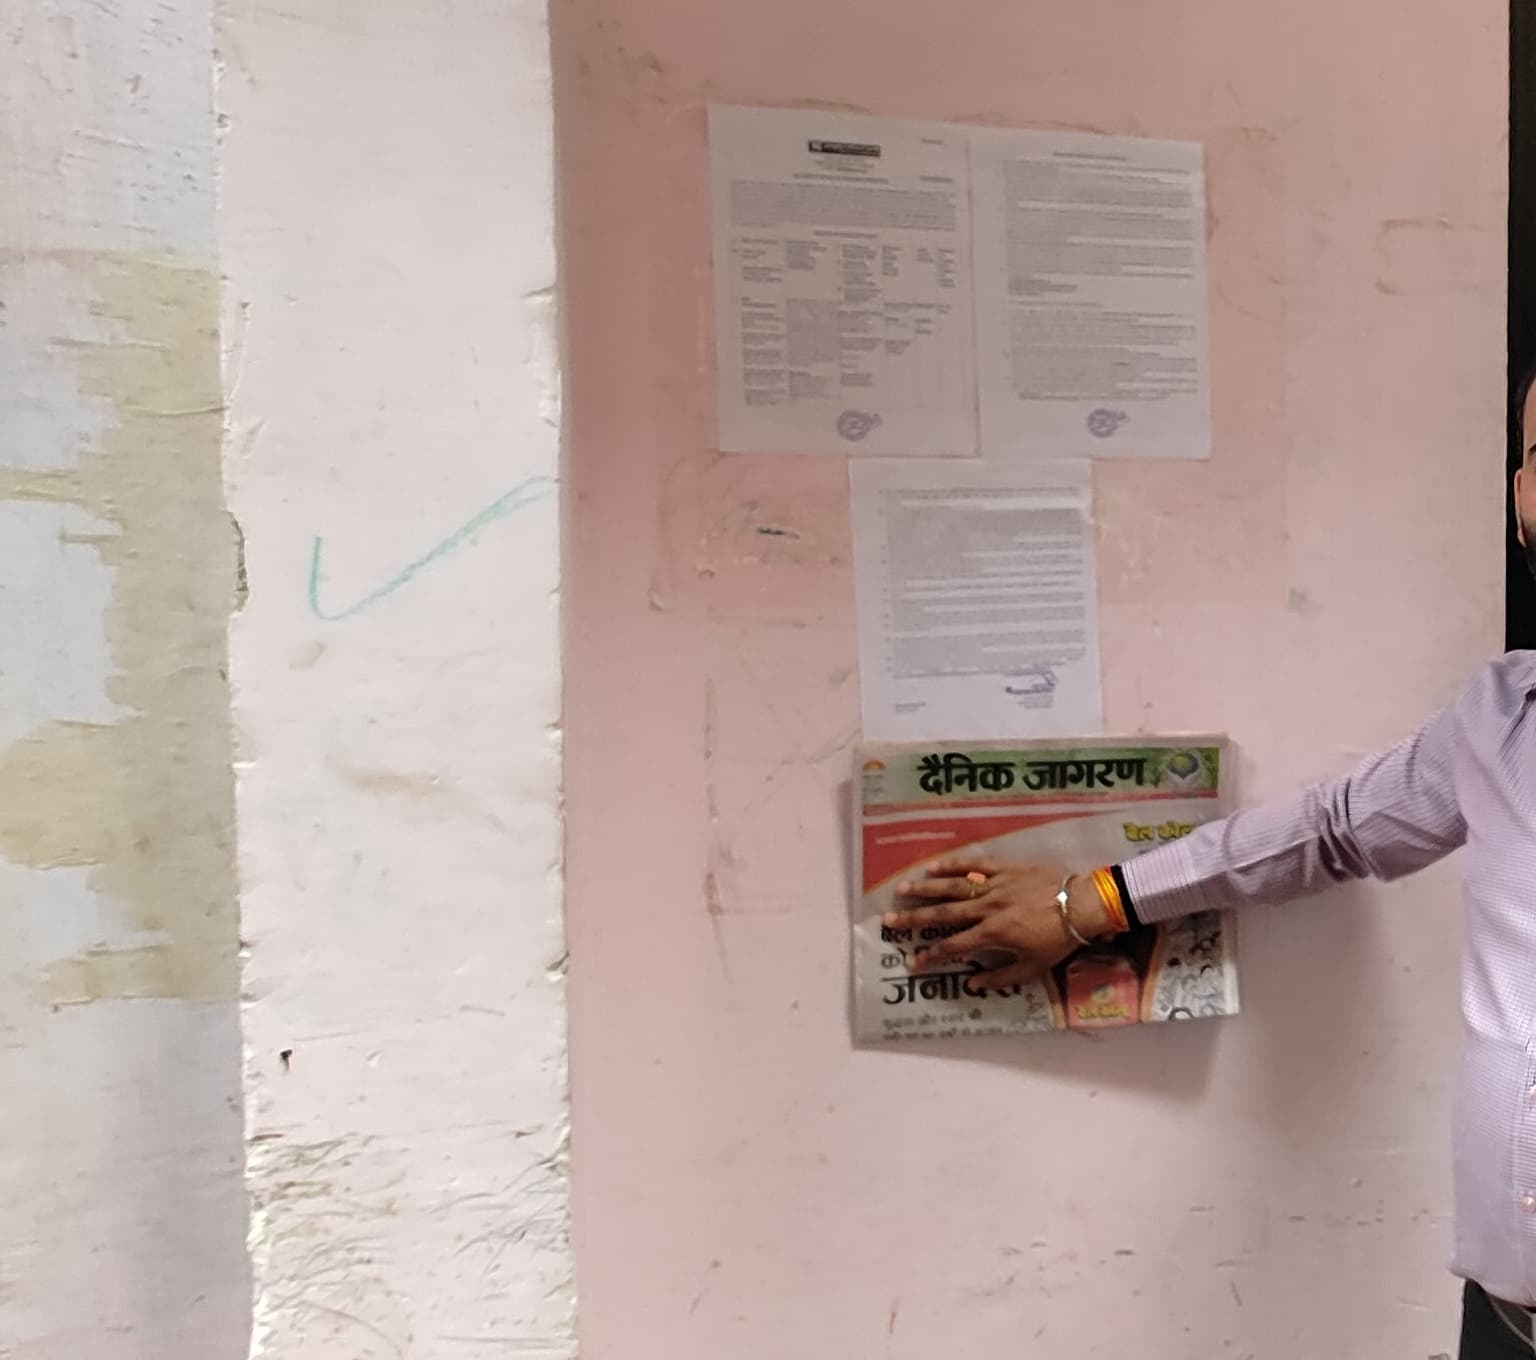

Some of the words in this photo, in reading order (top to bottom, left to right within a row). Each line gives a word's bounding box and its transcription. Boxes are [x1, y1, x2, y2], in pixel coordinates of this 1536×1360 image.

[917, 753, 1016, 796] दैनिक
[1022, 758, 1148, 791] जागरण
[881, 960, 1022, 1005] जनादे
